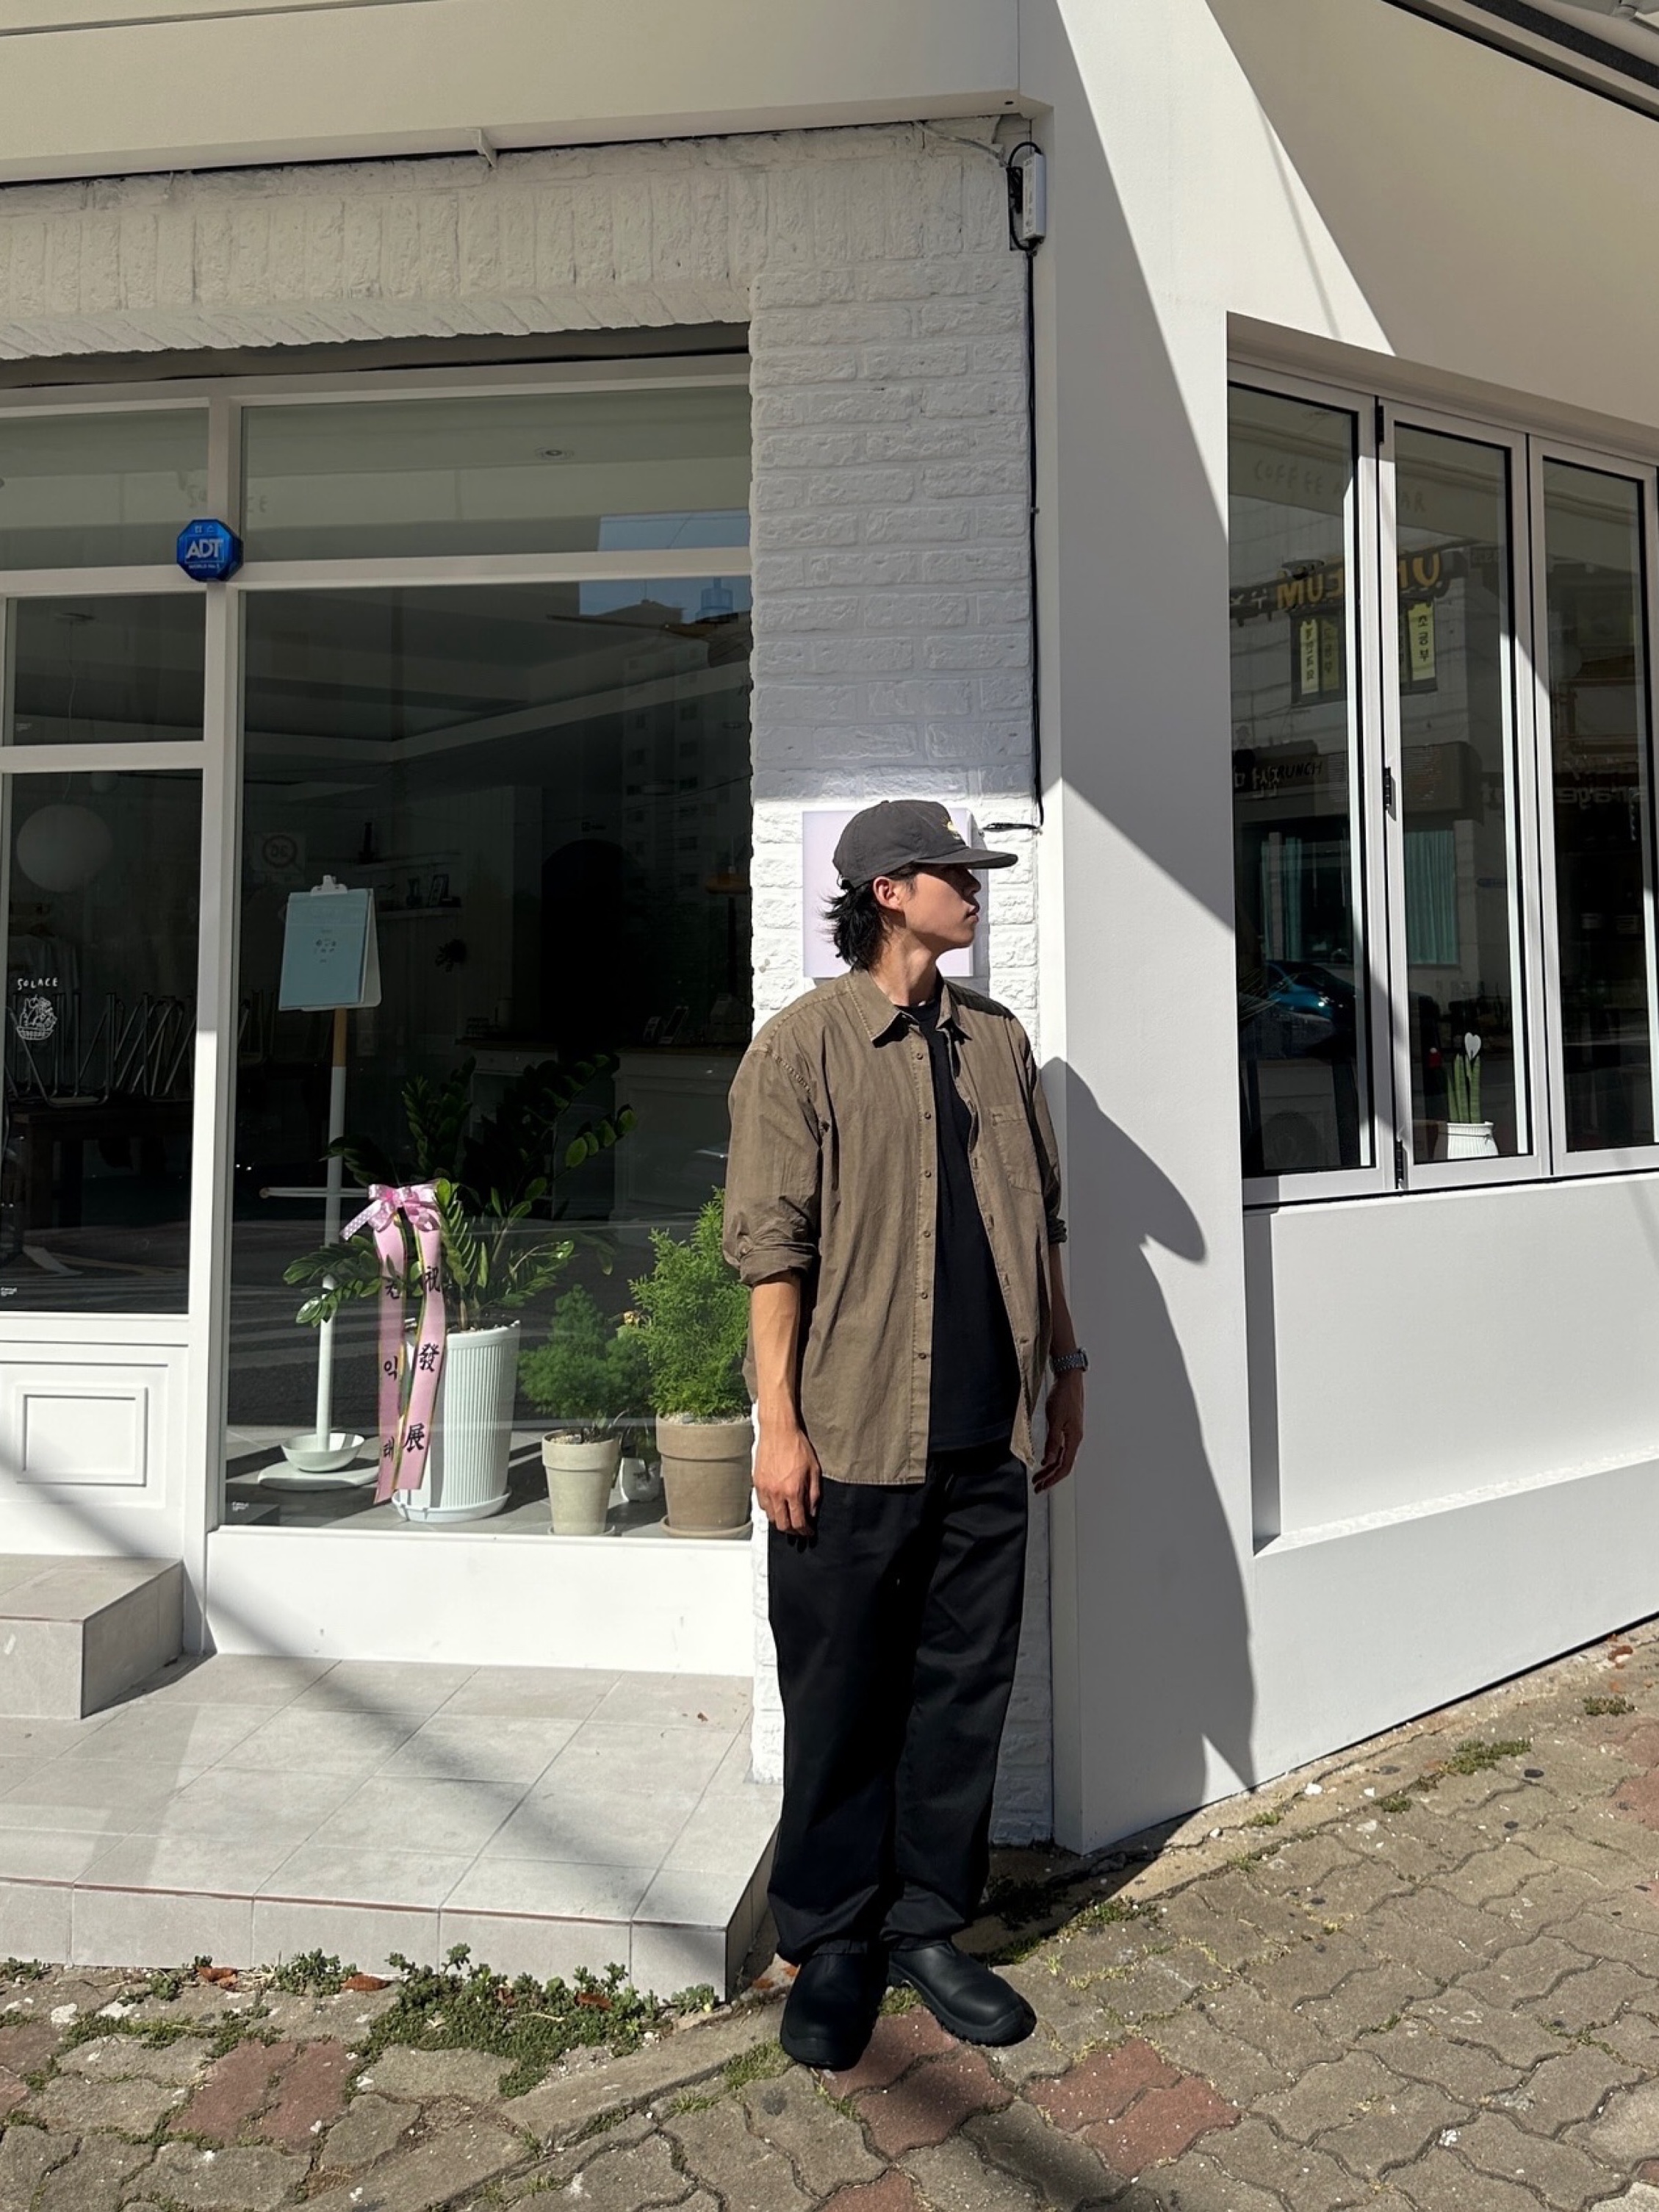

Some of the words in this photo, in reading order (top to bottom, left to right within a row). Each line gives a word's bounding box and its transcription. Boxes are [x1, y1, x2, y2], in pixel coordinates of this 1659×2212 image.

[1254, 460, 1323, 495] COFFEE
[185, 538, 223, 559] ADT
[17, 976, 59, 991] SOLACE
